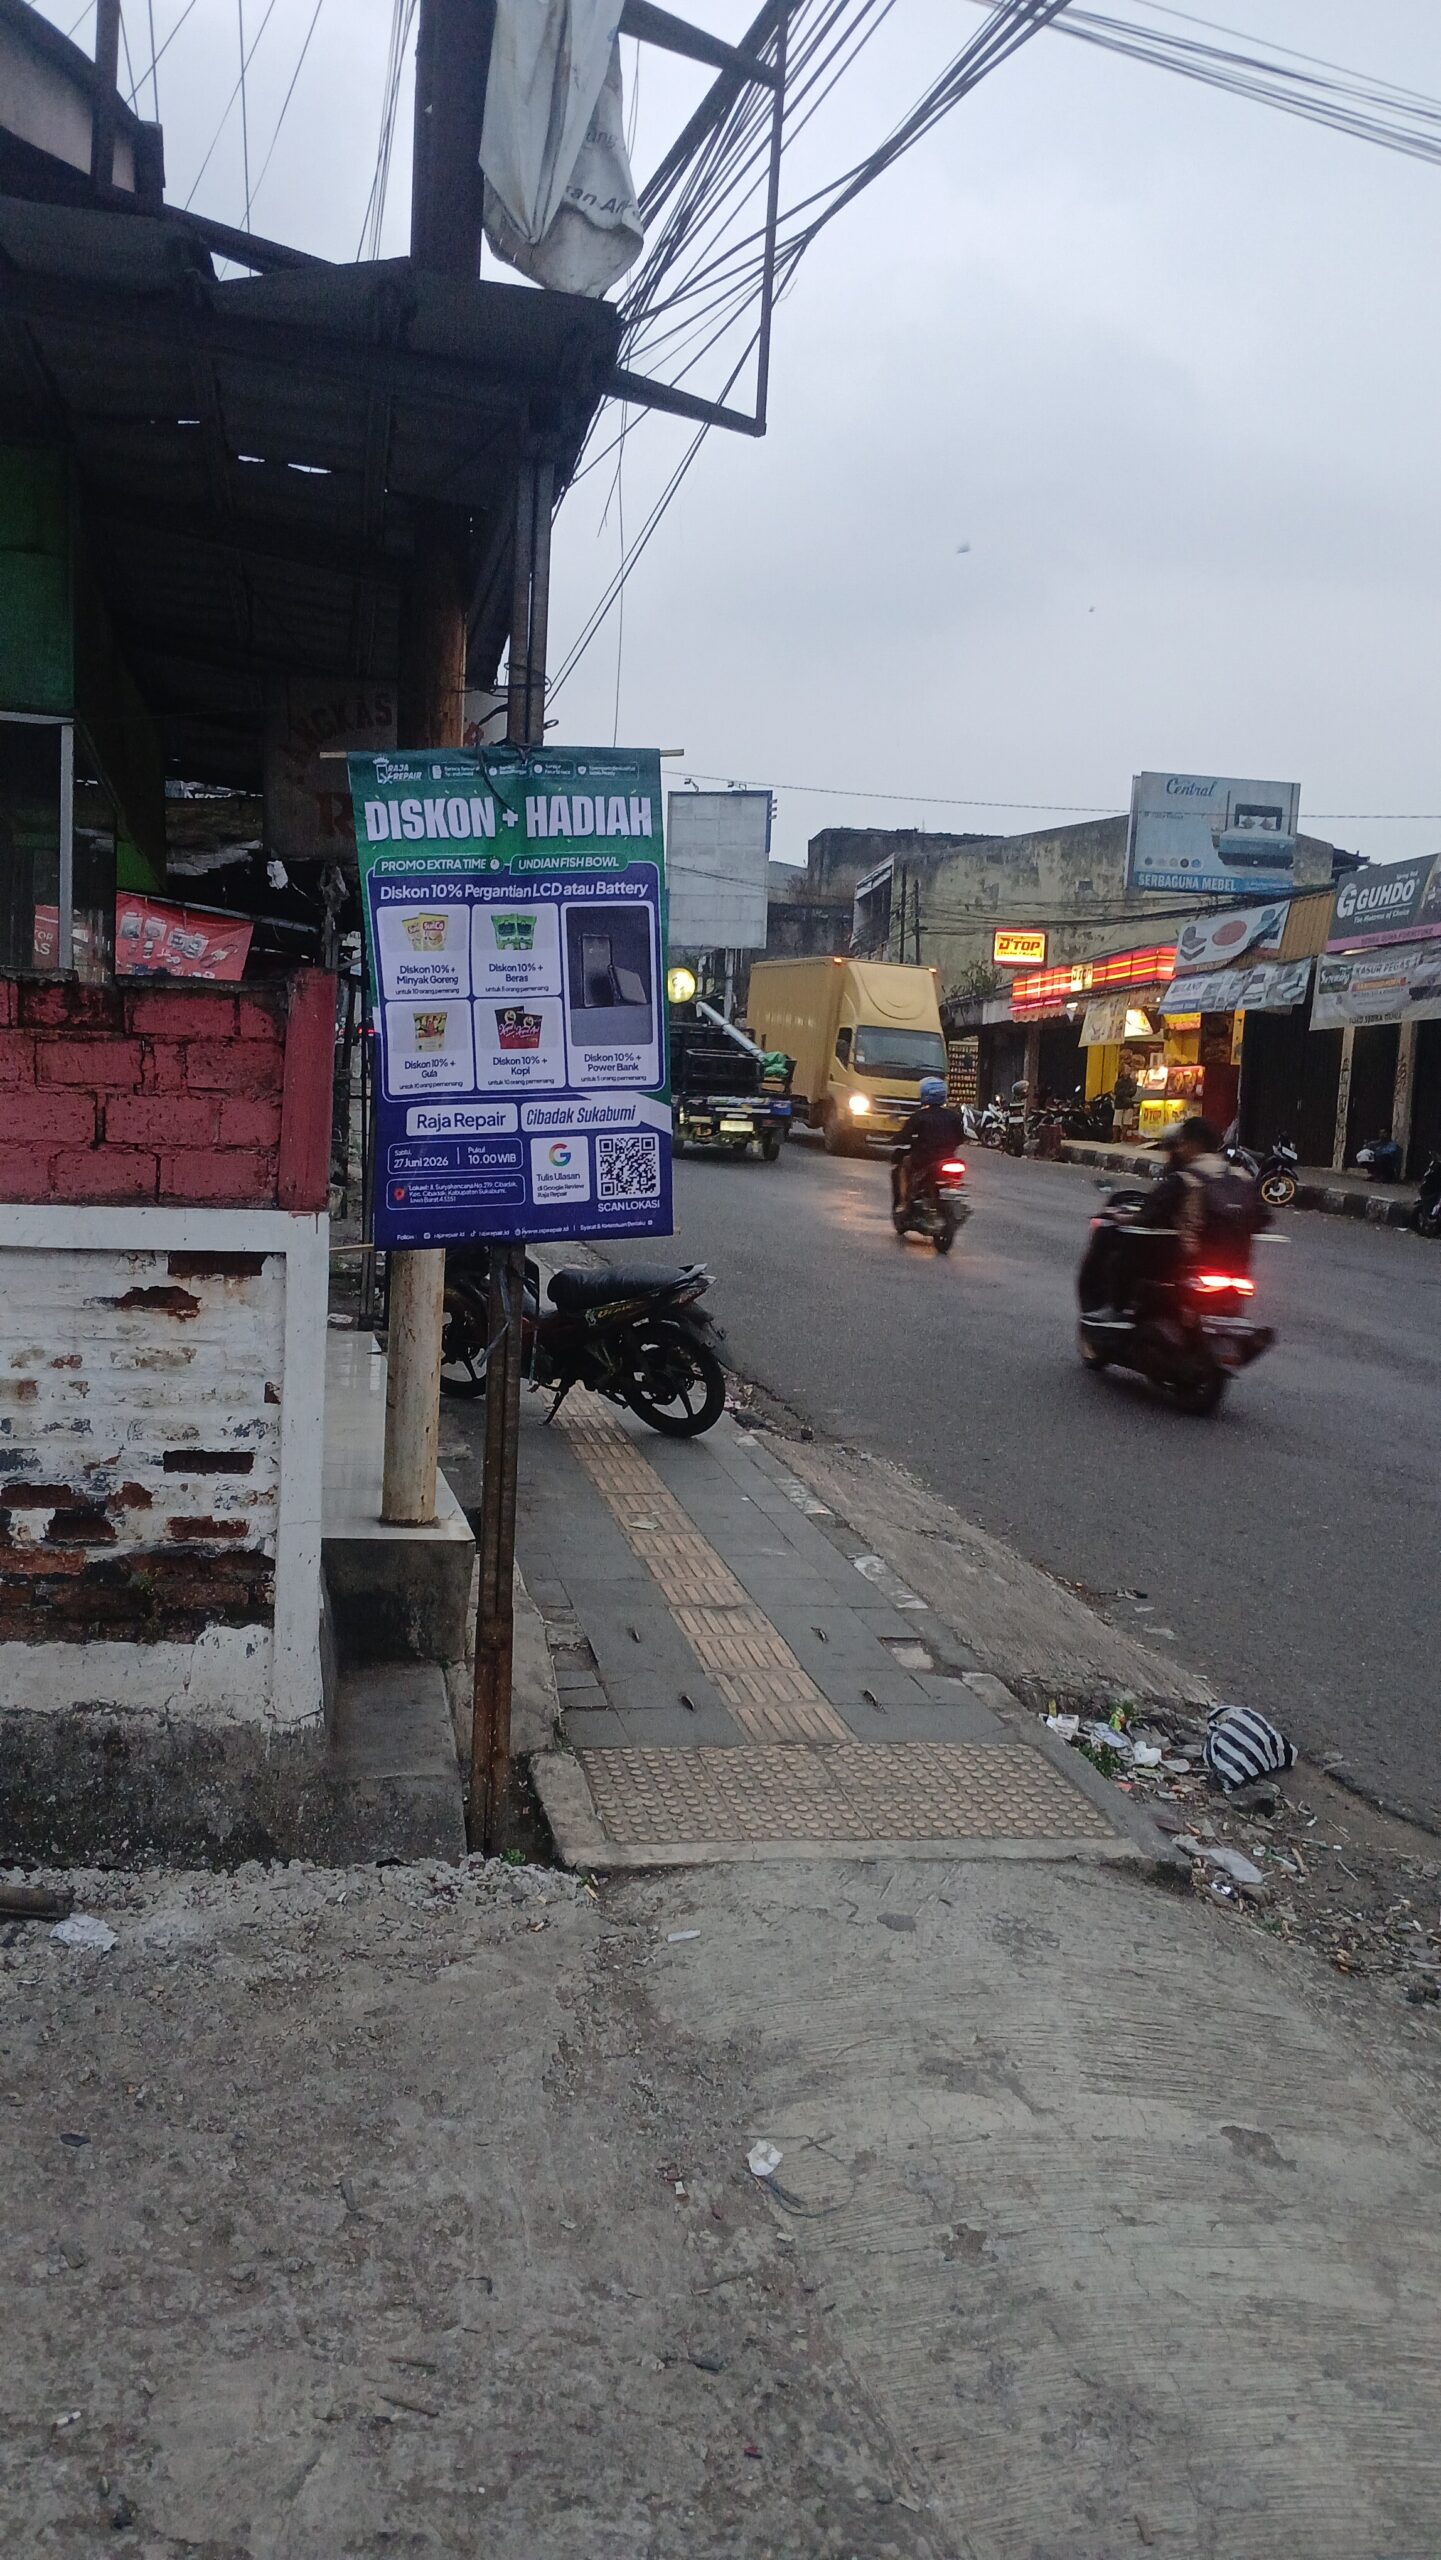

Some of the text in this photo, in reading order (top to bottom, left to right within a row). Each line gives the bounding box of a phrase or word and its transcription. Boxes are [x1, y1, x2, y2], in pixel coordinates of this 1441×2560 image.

[387, 763, 409, 772] RAJA
[392, 771, 423, 780] REPAIR
[1166, 777, 1218, 798] Central
[364, 795, 653, 842] DISKON + HADIAH
[381, 858, 486, 872] PROMO EXTRA TIME
[518, 856, 619, 870] UNDIAN FISH BOWL
[1137, 873, 1199, 889] SERBAGUNA
[1201, 877, 1237, 891] MEBEL
[380, 881, 649, 901] Diskon 10% Pergantian LCD atau Battery
[1356, 879, 1416, 910] GUHDO
[998, 937, 1041, 951] D'TOP
[399, 965, 431, 974] Diskon
[431, 964, 450, 974] 10%
[488, 963, 517, 972] Diskon
[517, 962, 536, 972] 10%
[396, 975, 459, 987] Minyak Goreng
[505, 973, 529, 982] Beras
[492, 1057, 521, 1066] Diskon
[521, 1056, 540, 1065] 10%
[584, 1053, 613, 1062] Diskon
[614, 1052, 635, 1062] 10%
[404, 1060, 431, 1070] Diskon
[431, 1058, 448, 1068] 10%
[587, 1062, 639, 1072] Power Bank
[421, 1069, 438, 1079] Gula
[511, 1066, 531, 1077] Kopi
[417, 1104, 637, 1132] Raja Repair Cibadak Sukabumi
[467, 1146, 486, 1154] Pukul
[393, 1156, 449, 1169] 27 Juni 2026
[468, 1153, 517, 1165] 10.00 WIB
[536, 1172, 581, 1182] Tulis Ulasan
[597, 1199, 660, 1213] SCAN LOKASI
